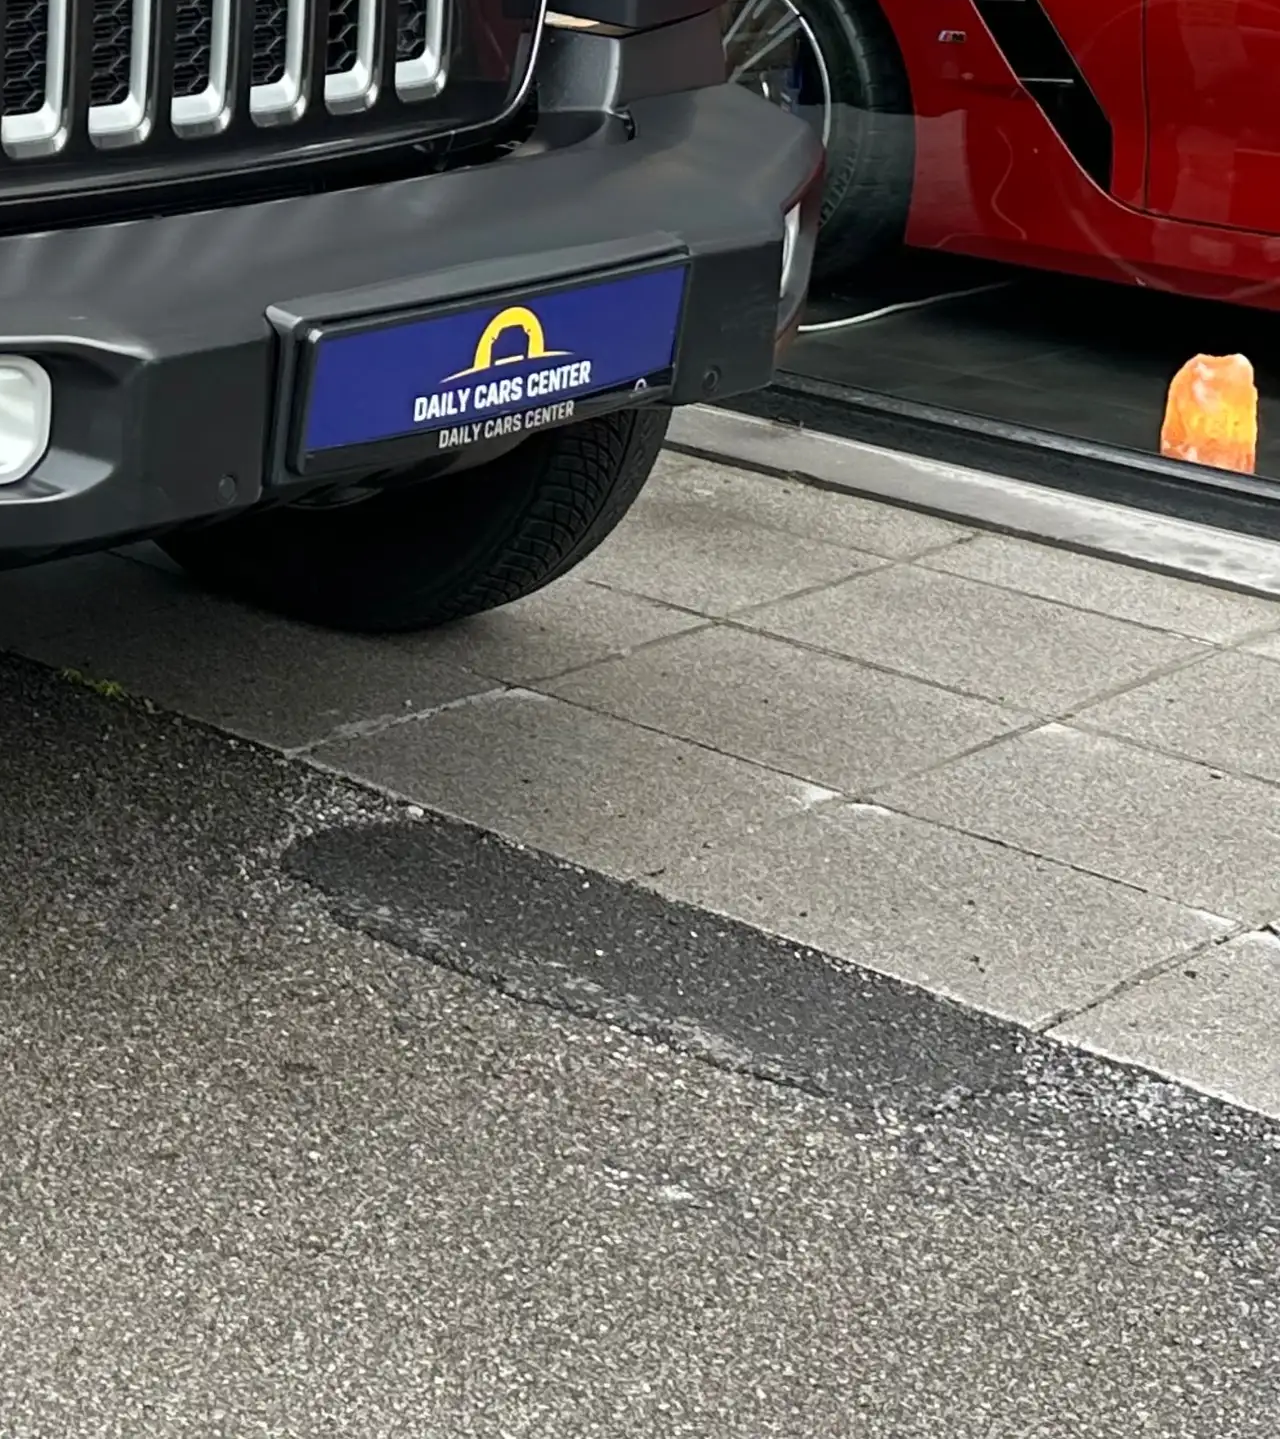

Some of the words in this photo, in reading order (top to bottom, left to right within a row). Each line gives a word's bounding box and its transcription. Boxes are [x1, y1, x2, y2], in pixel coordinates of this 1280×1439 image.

[414, 388, 468, 423] DAILY
[474, 376, 523, 409] CARS
[527, 360, 592, 395] CENTER
[438, 422, 481, 449] DAILY
[484, 413, 523, 439] CARS
[525, 400, 575, 429] CENTER
